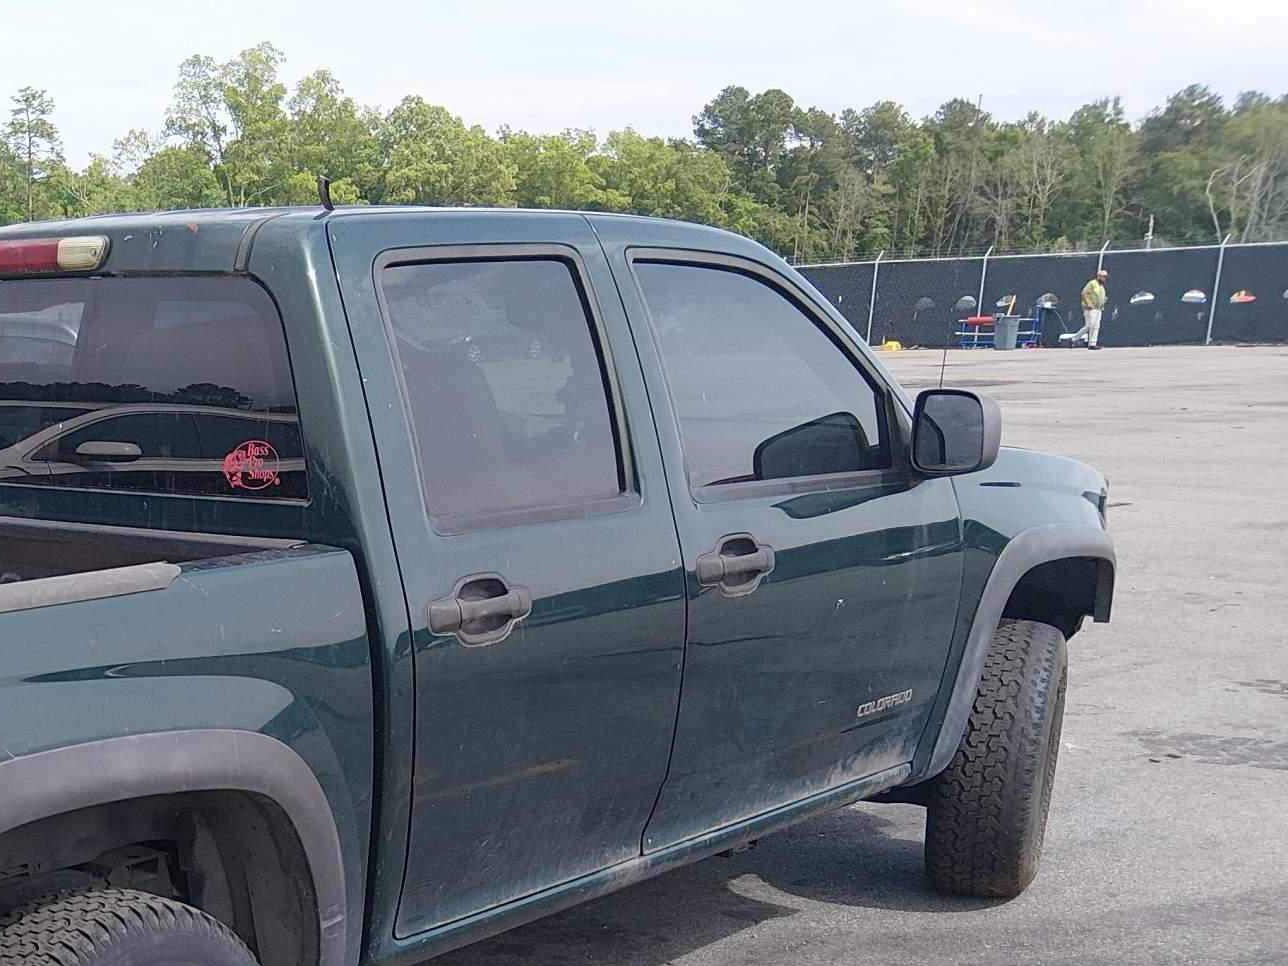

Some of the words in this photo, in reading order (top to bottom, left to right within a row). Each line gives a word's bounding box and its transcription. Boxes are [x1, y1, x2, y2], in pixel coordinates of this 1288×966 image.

[247, 443, 269, 456] Bass
[248, 456, 264, 471] Pro
[248, 469, 273, 482] Shops
[856, 688, 913, 717] COLORADO
